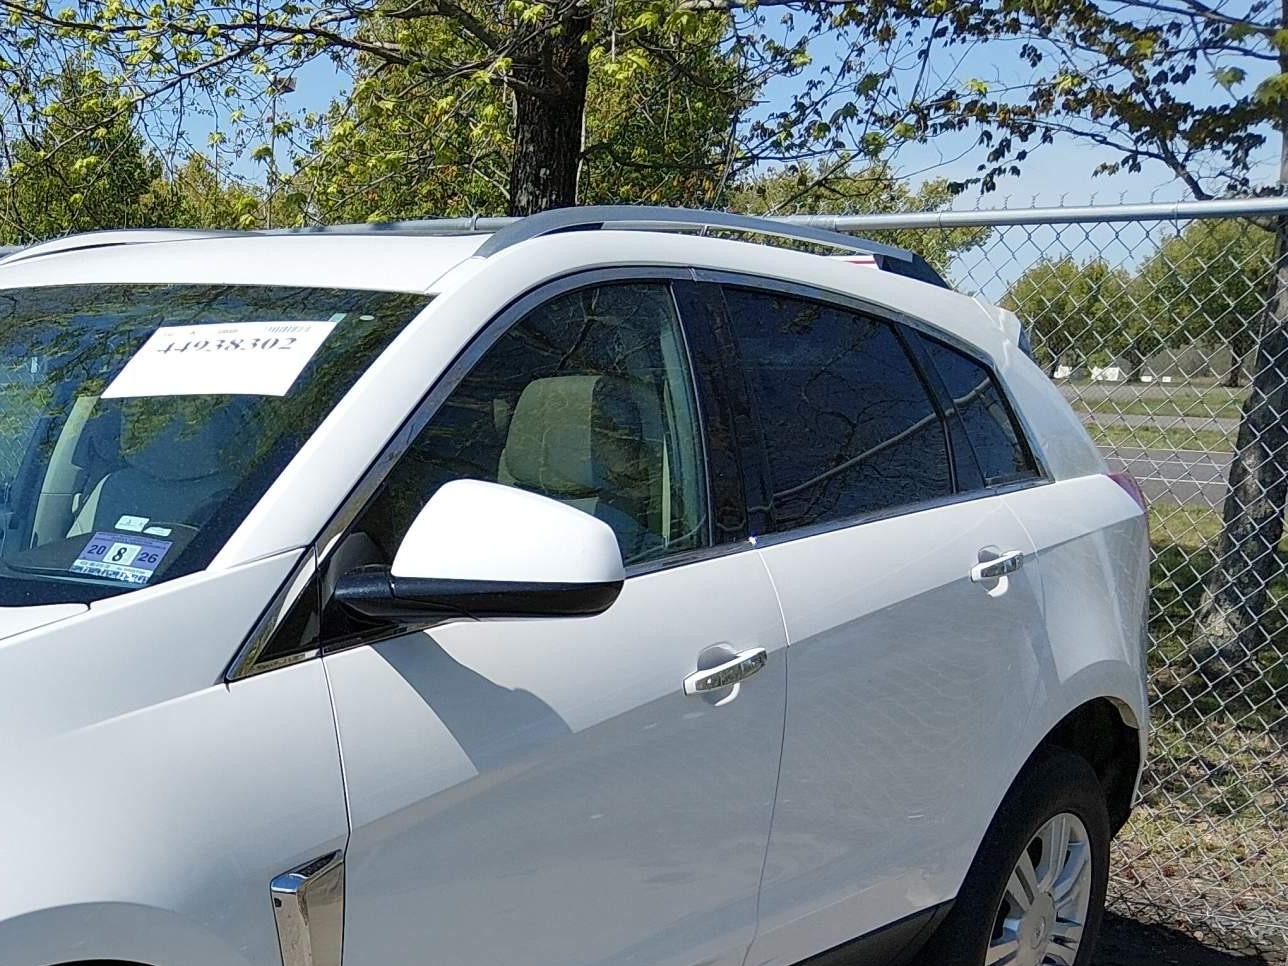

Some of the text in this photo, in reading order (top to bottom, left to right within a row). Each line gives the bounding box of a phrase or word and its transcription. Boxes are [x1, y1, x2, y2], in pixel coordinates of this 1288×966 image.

[157, 337, 298, 354] 44938302
[87, 544, 159, 564] 20 8 26
